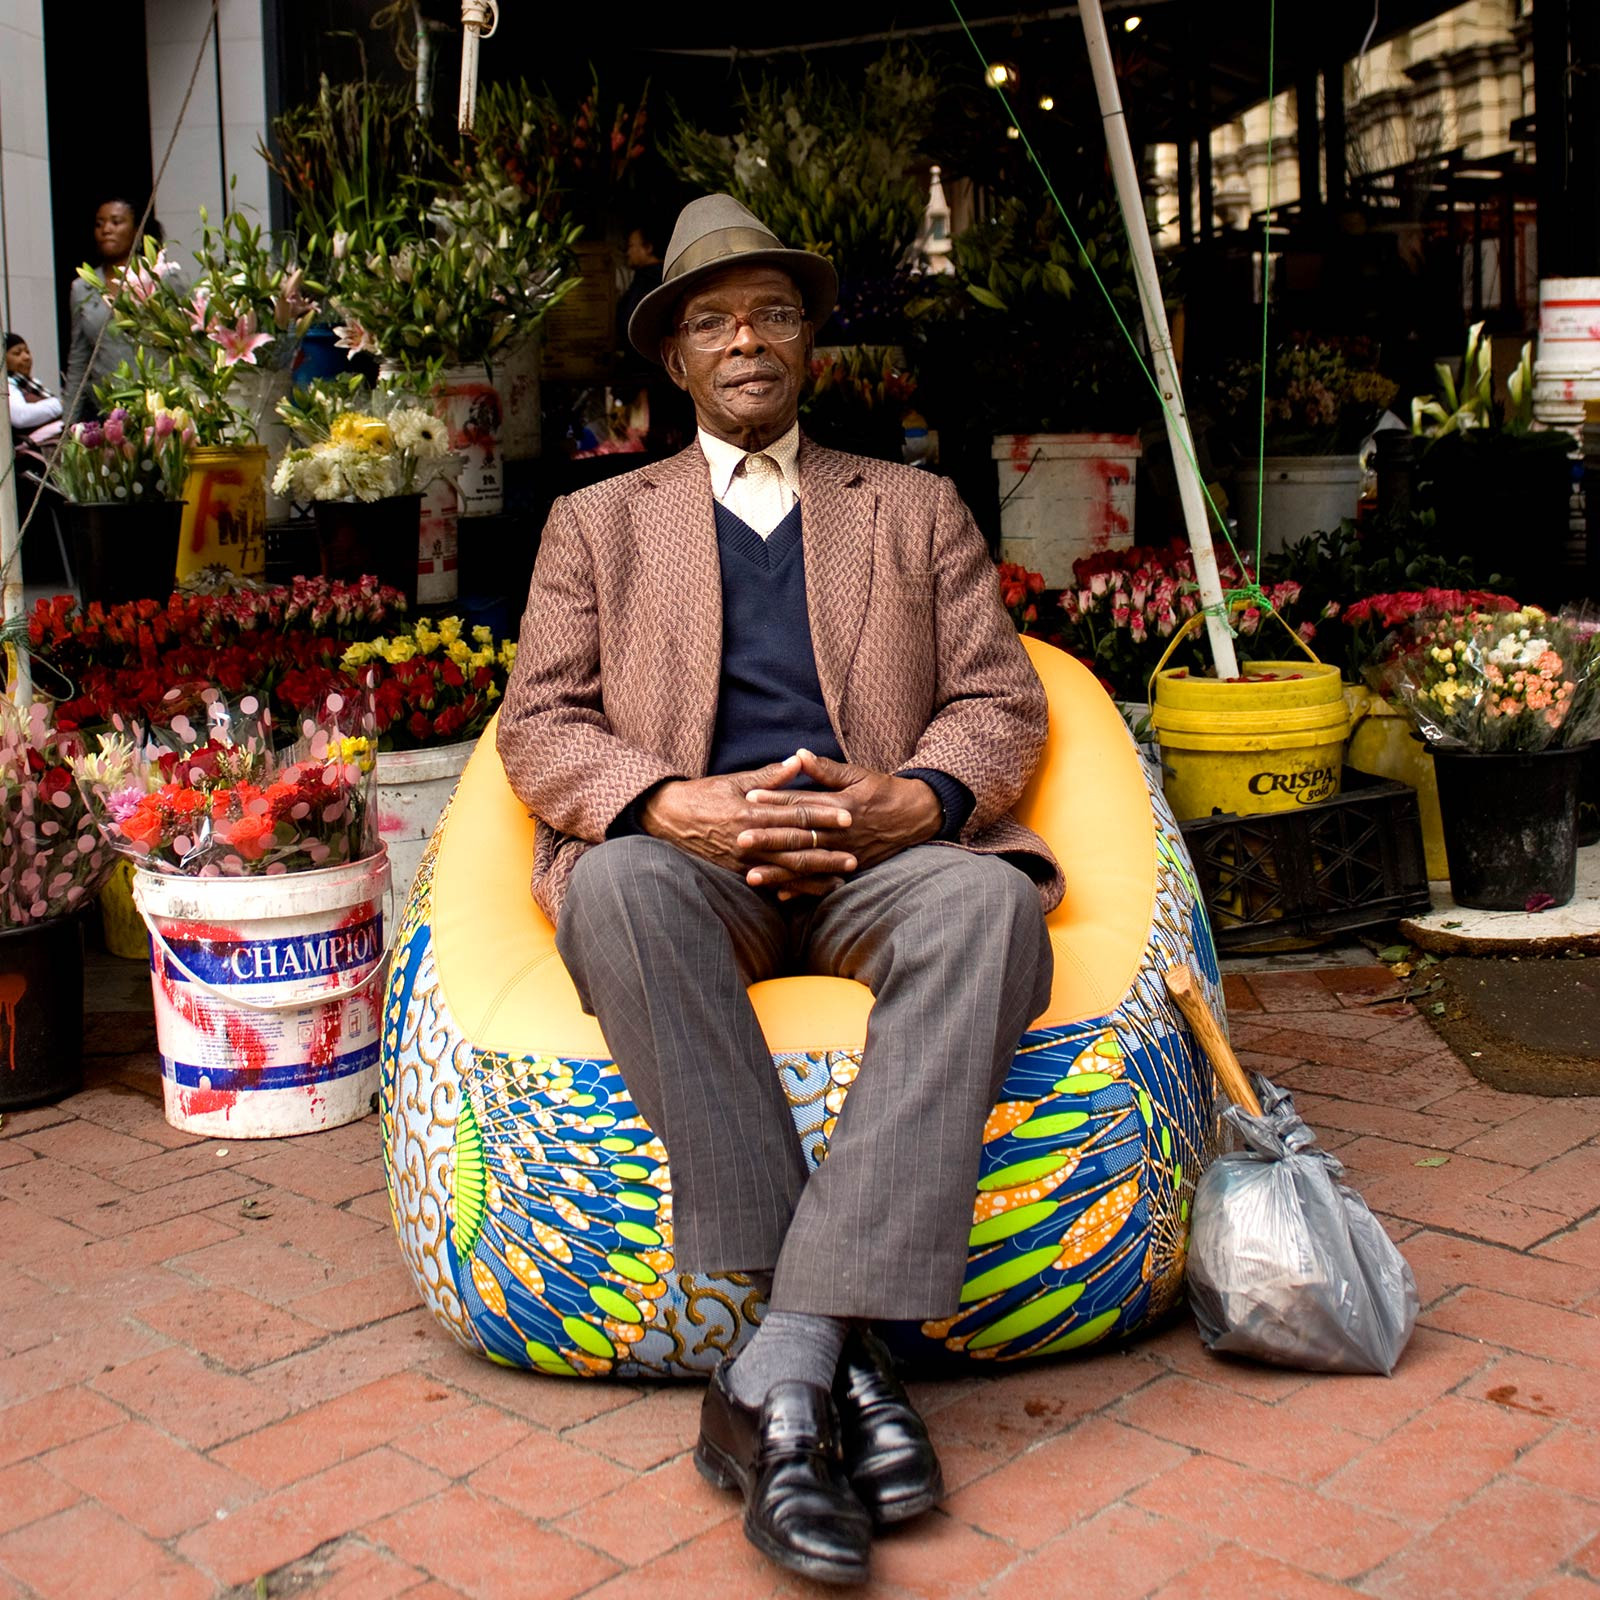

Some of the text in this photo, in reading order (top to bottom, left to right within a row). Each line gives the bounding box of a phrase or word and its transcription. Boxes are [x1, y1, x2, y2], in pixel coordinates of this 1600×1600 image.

[1248, 767, 1333, 795] CRISPA
[1307, 783, 1330, 801] gold
[231, 923, 378, 979] CHAMPION
